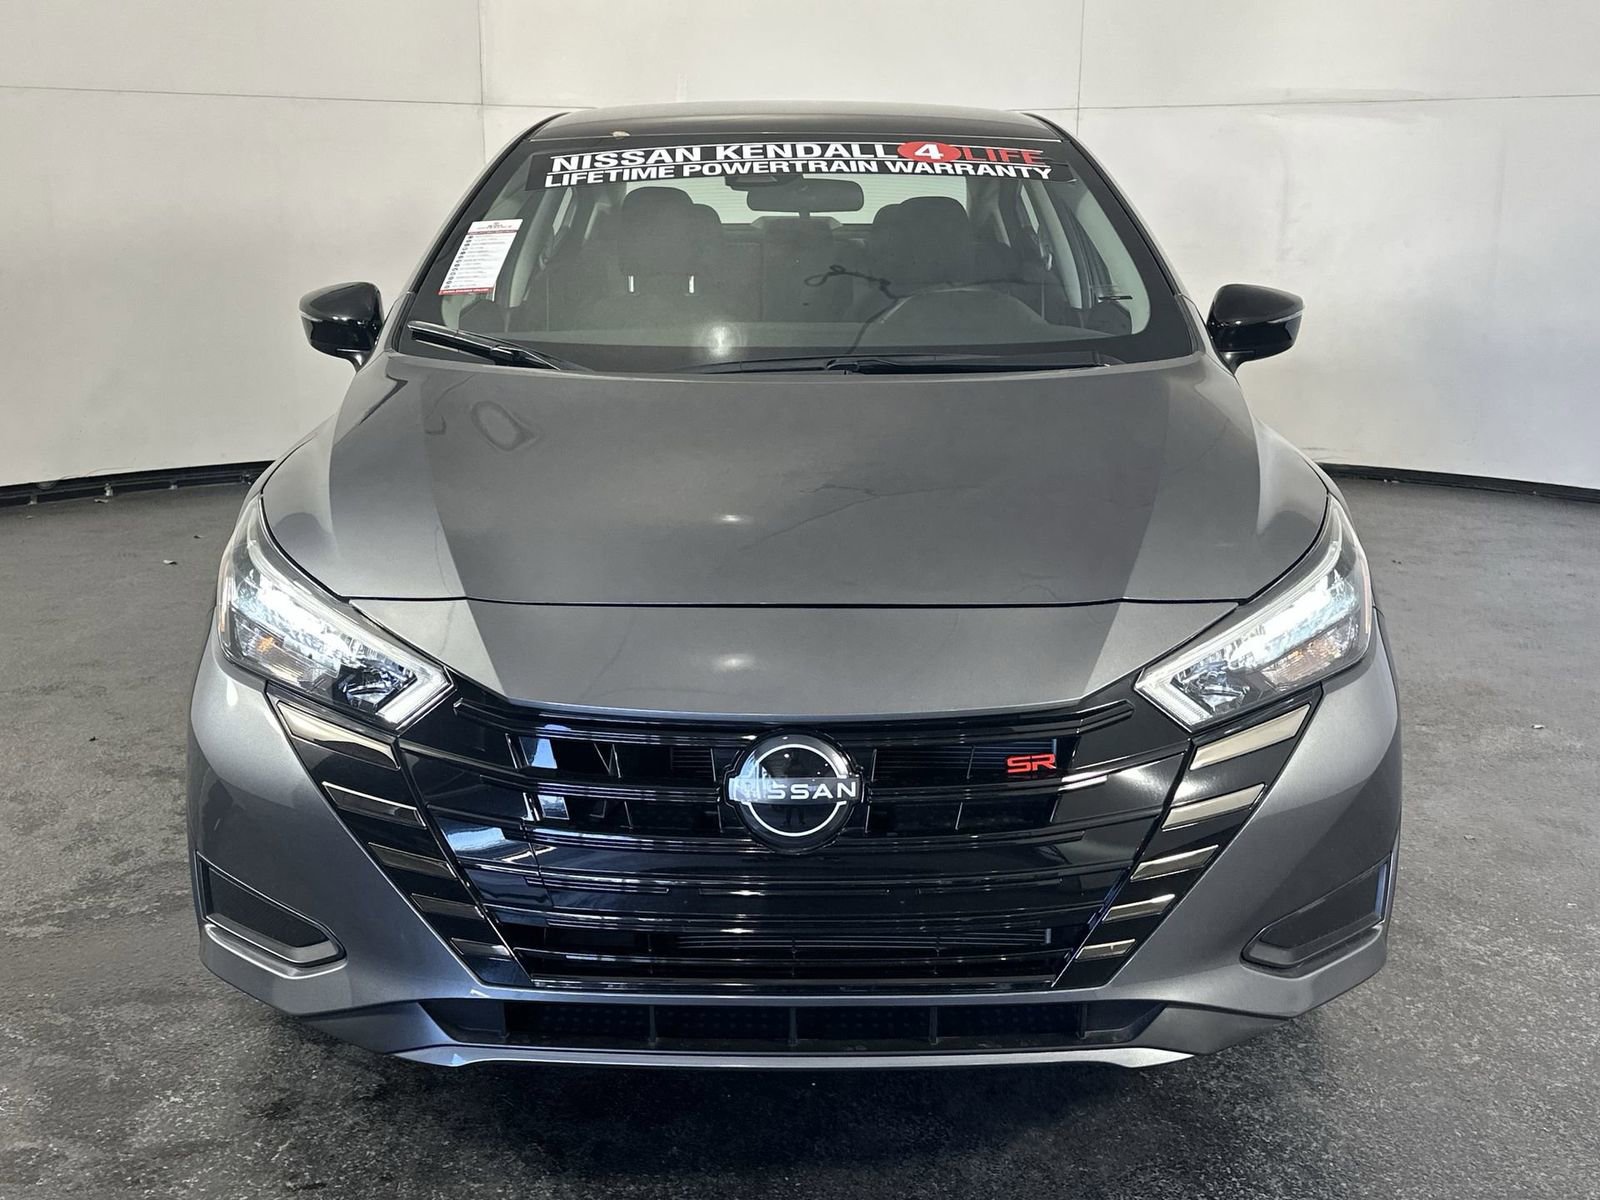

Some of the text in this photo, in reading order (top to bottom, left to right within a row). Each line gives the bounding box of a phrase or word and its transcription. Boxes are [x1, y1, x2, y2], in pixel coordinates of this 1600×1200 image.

[551, 144, 1046, 172] NISSAN KENDALL 4 LIFE
[544, 160, 1052, 188] LIFETIME POWERTRAIN WARRANTY
[1006, 753, 1056, 773] SR
